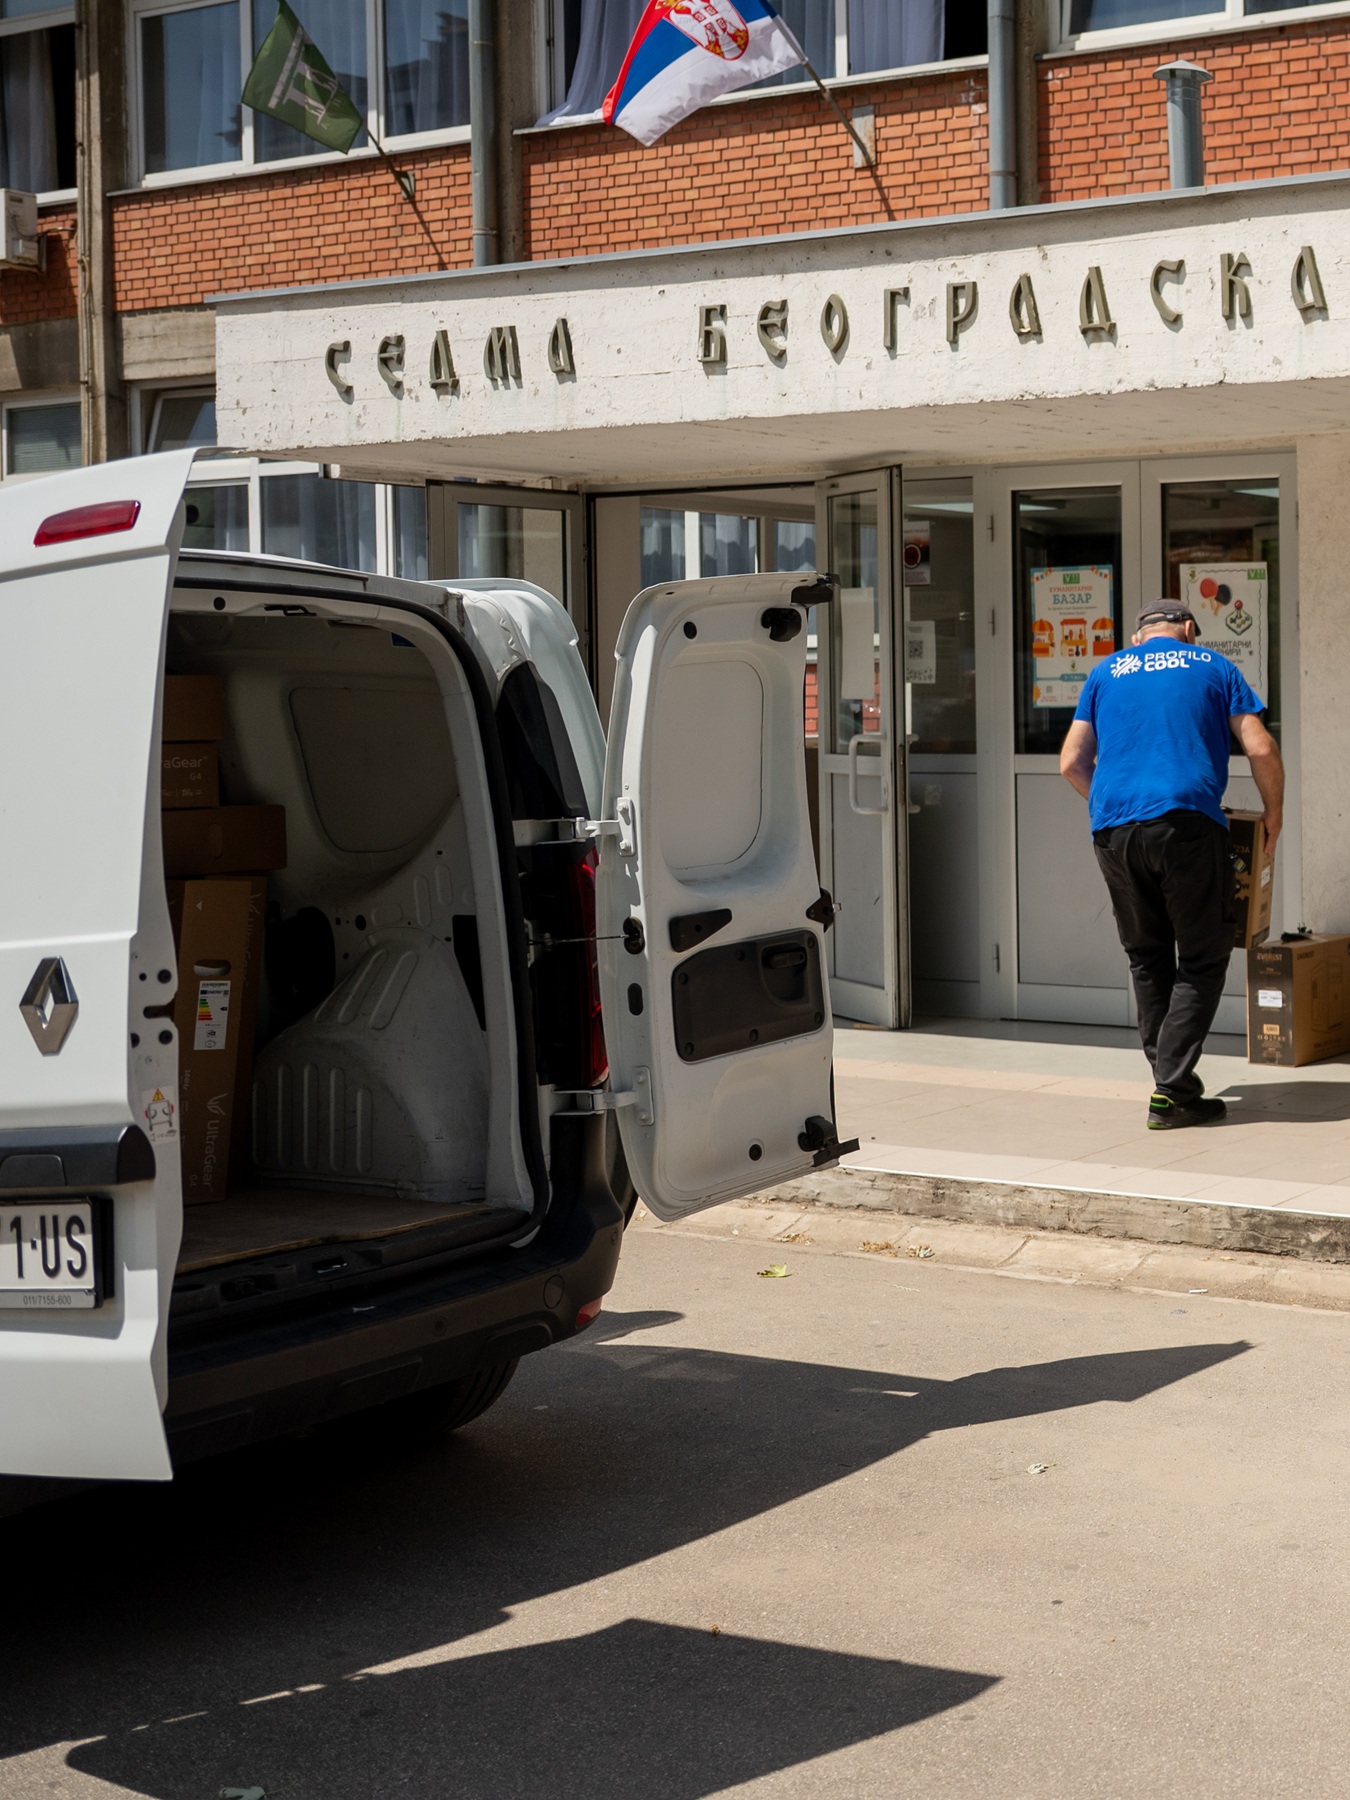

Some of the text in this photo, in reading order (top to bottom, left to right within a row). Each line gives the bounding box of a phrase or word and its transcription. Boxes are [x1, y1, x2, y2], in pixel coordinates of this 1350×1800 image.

[325, 318, 577, 394] СЕДМА
[697, 246, 1328, 362] БЕОГРАДСКА
[1052, 593, 1092, 605] БАЗАР
[1144, 650, 1212, 663] PROFILO
[1144, 658, 1190, 672] COOL
[161, 756, 203, 769] aGear
[202, 1119, 220, 1188] UltraGear
[0, 1215, 87, 1279] 1-US
[23, 1295, 72, 1305] 011/7155-600
